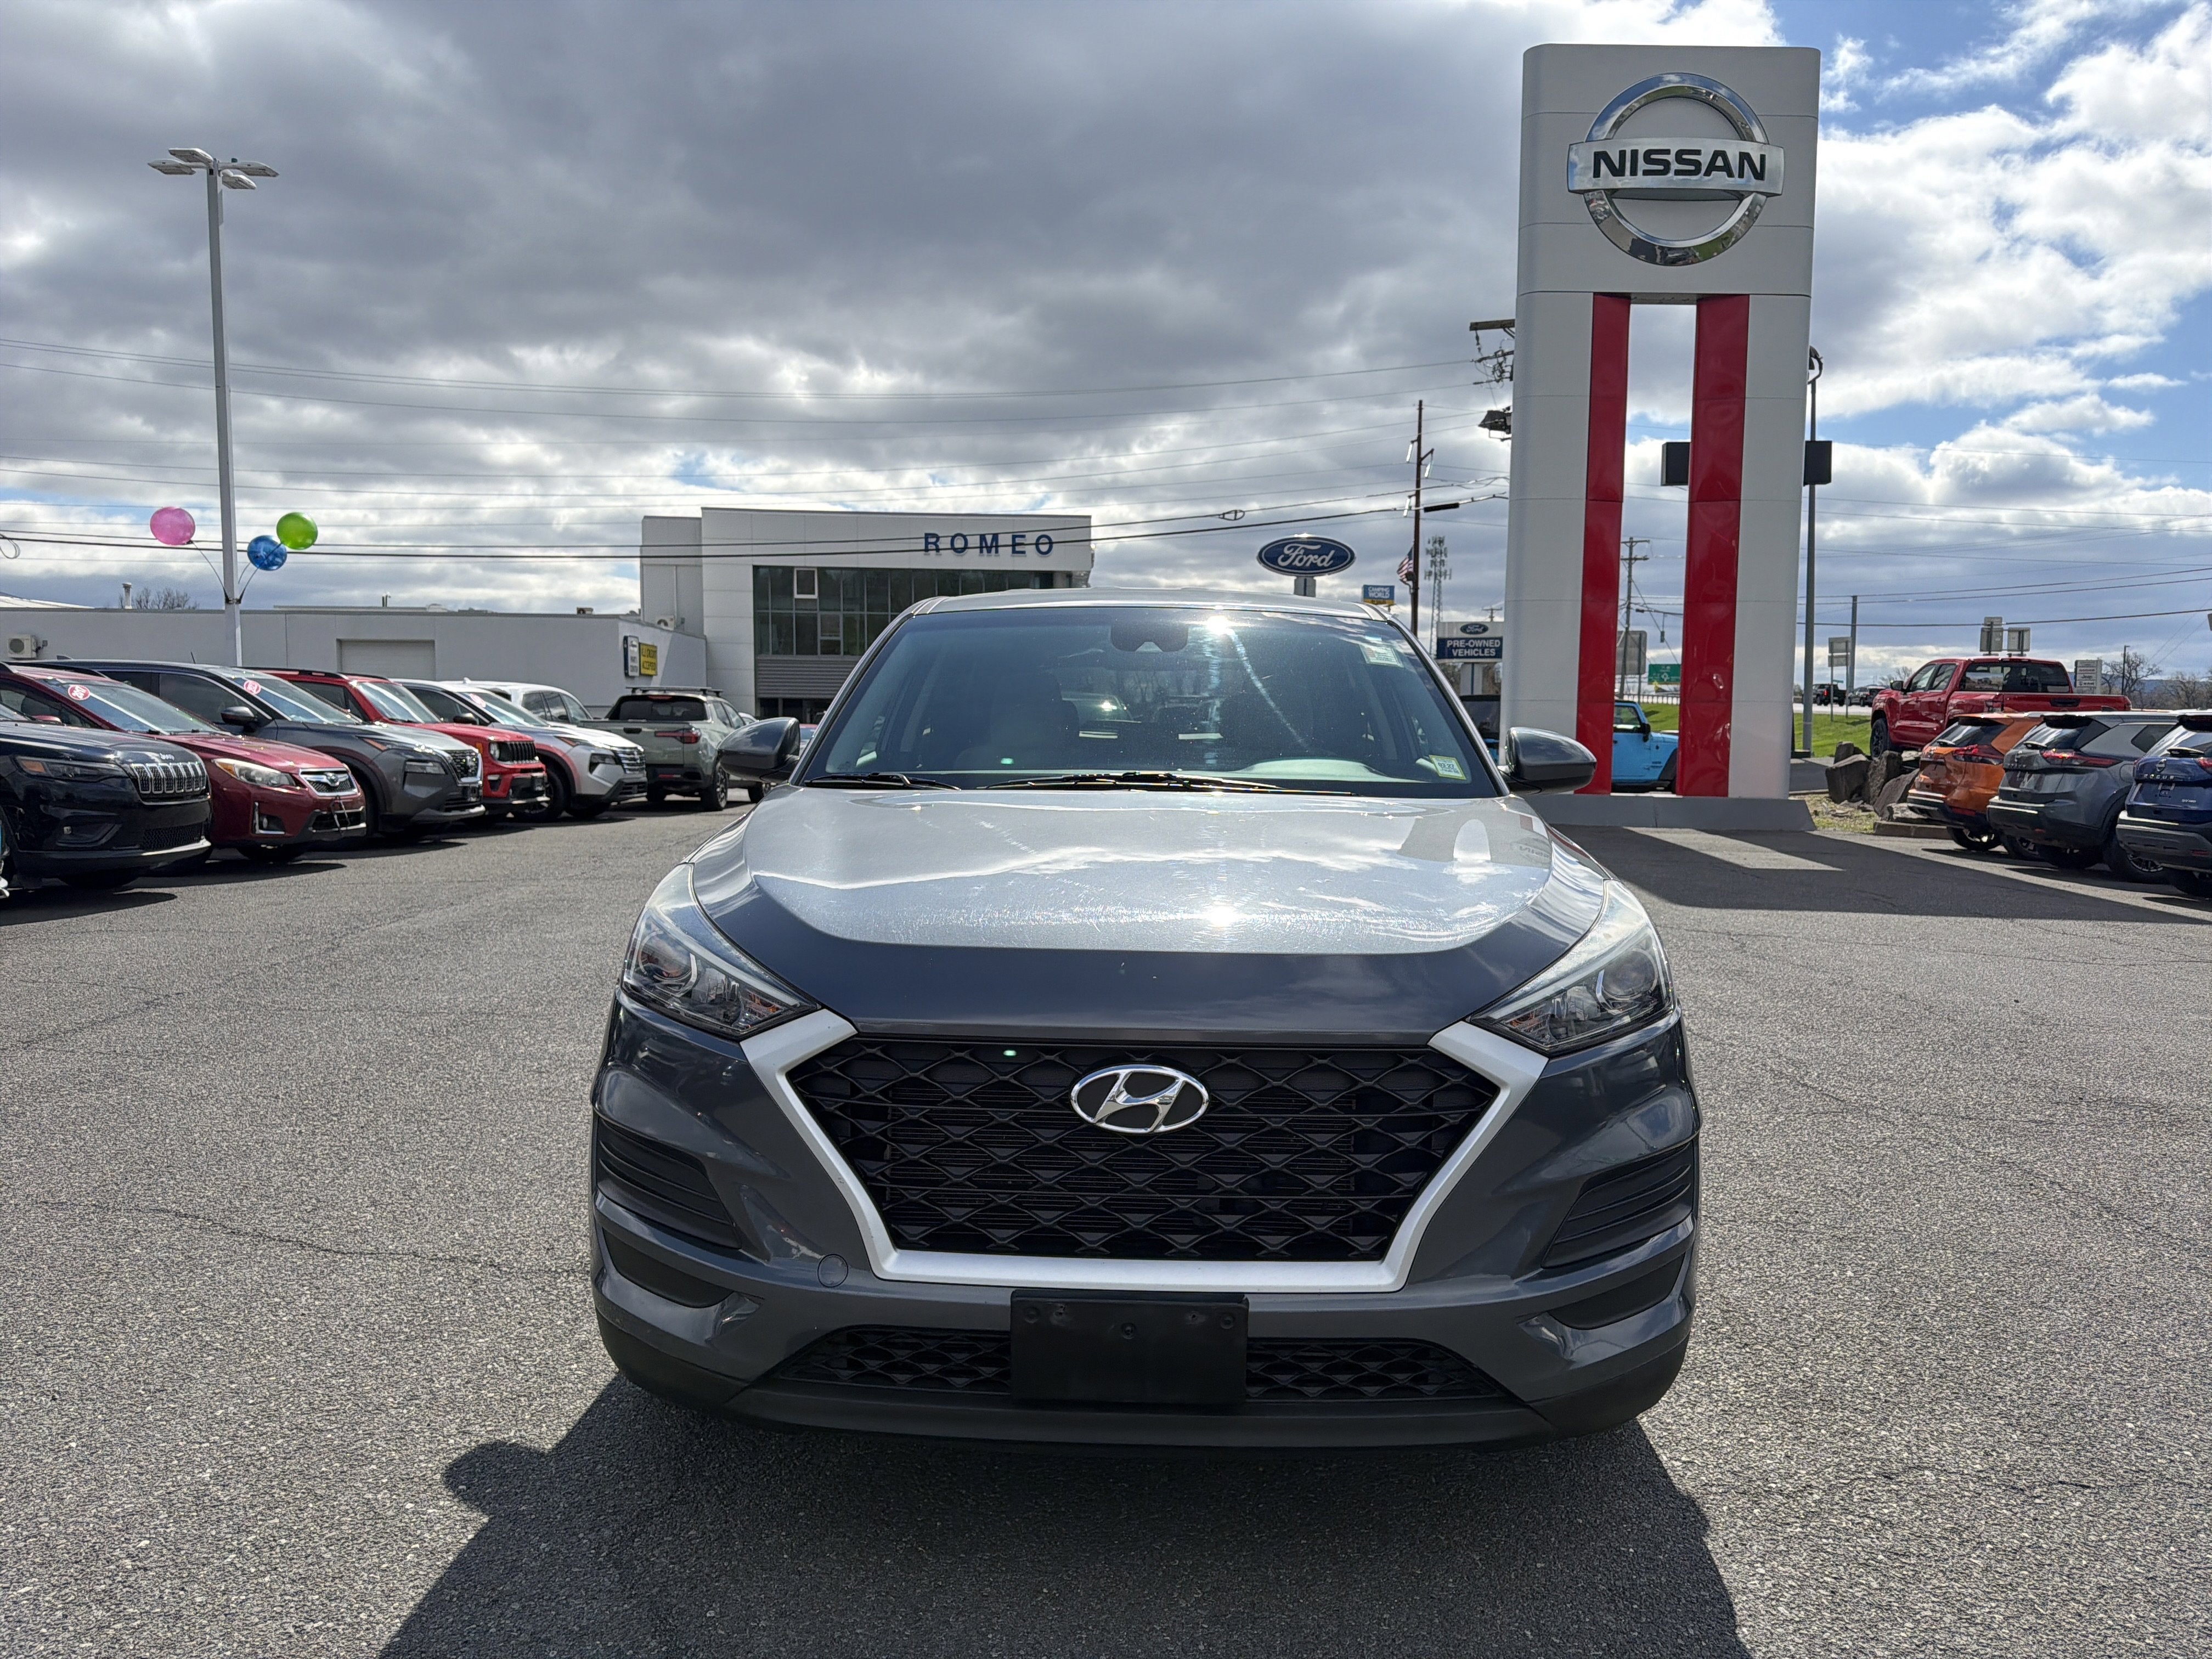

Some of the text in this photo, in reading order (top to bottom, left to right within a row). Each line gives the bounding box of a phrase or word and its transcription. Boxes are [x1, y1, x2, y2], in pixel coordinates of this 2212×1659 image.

[1592, 148, 1767, 181] NISSAN
[924, 532, 1053, 555] ROMEO
[1277, 543, 1335, 567] Ford
[1466, 624, 1484, 633] Ford
[1446, 639, 1501, 648] PRE-OWNED
[1452, 648, 1496, 657] VEHICLES
